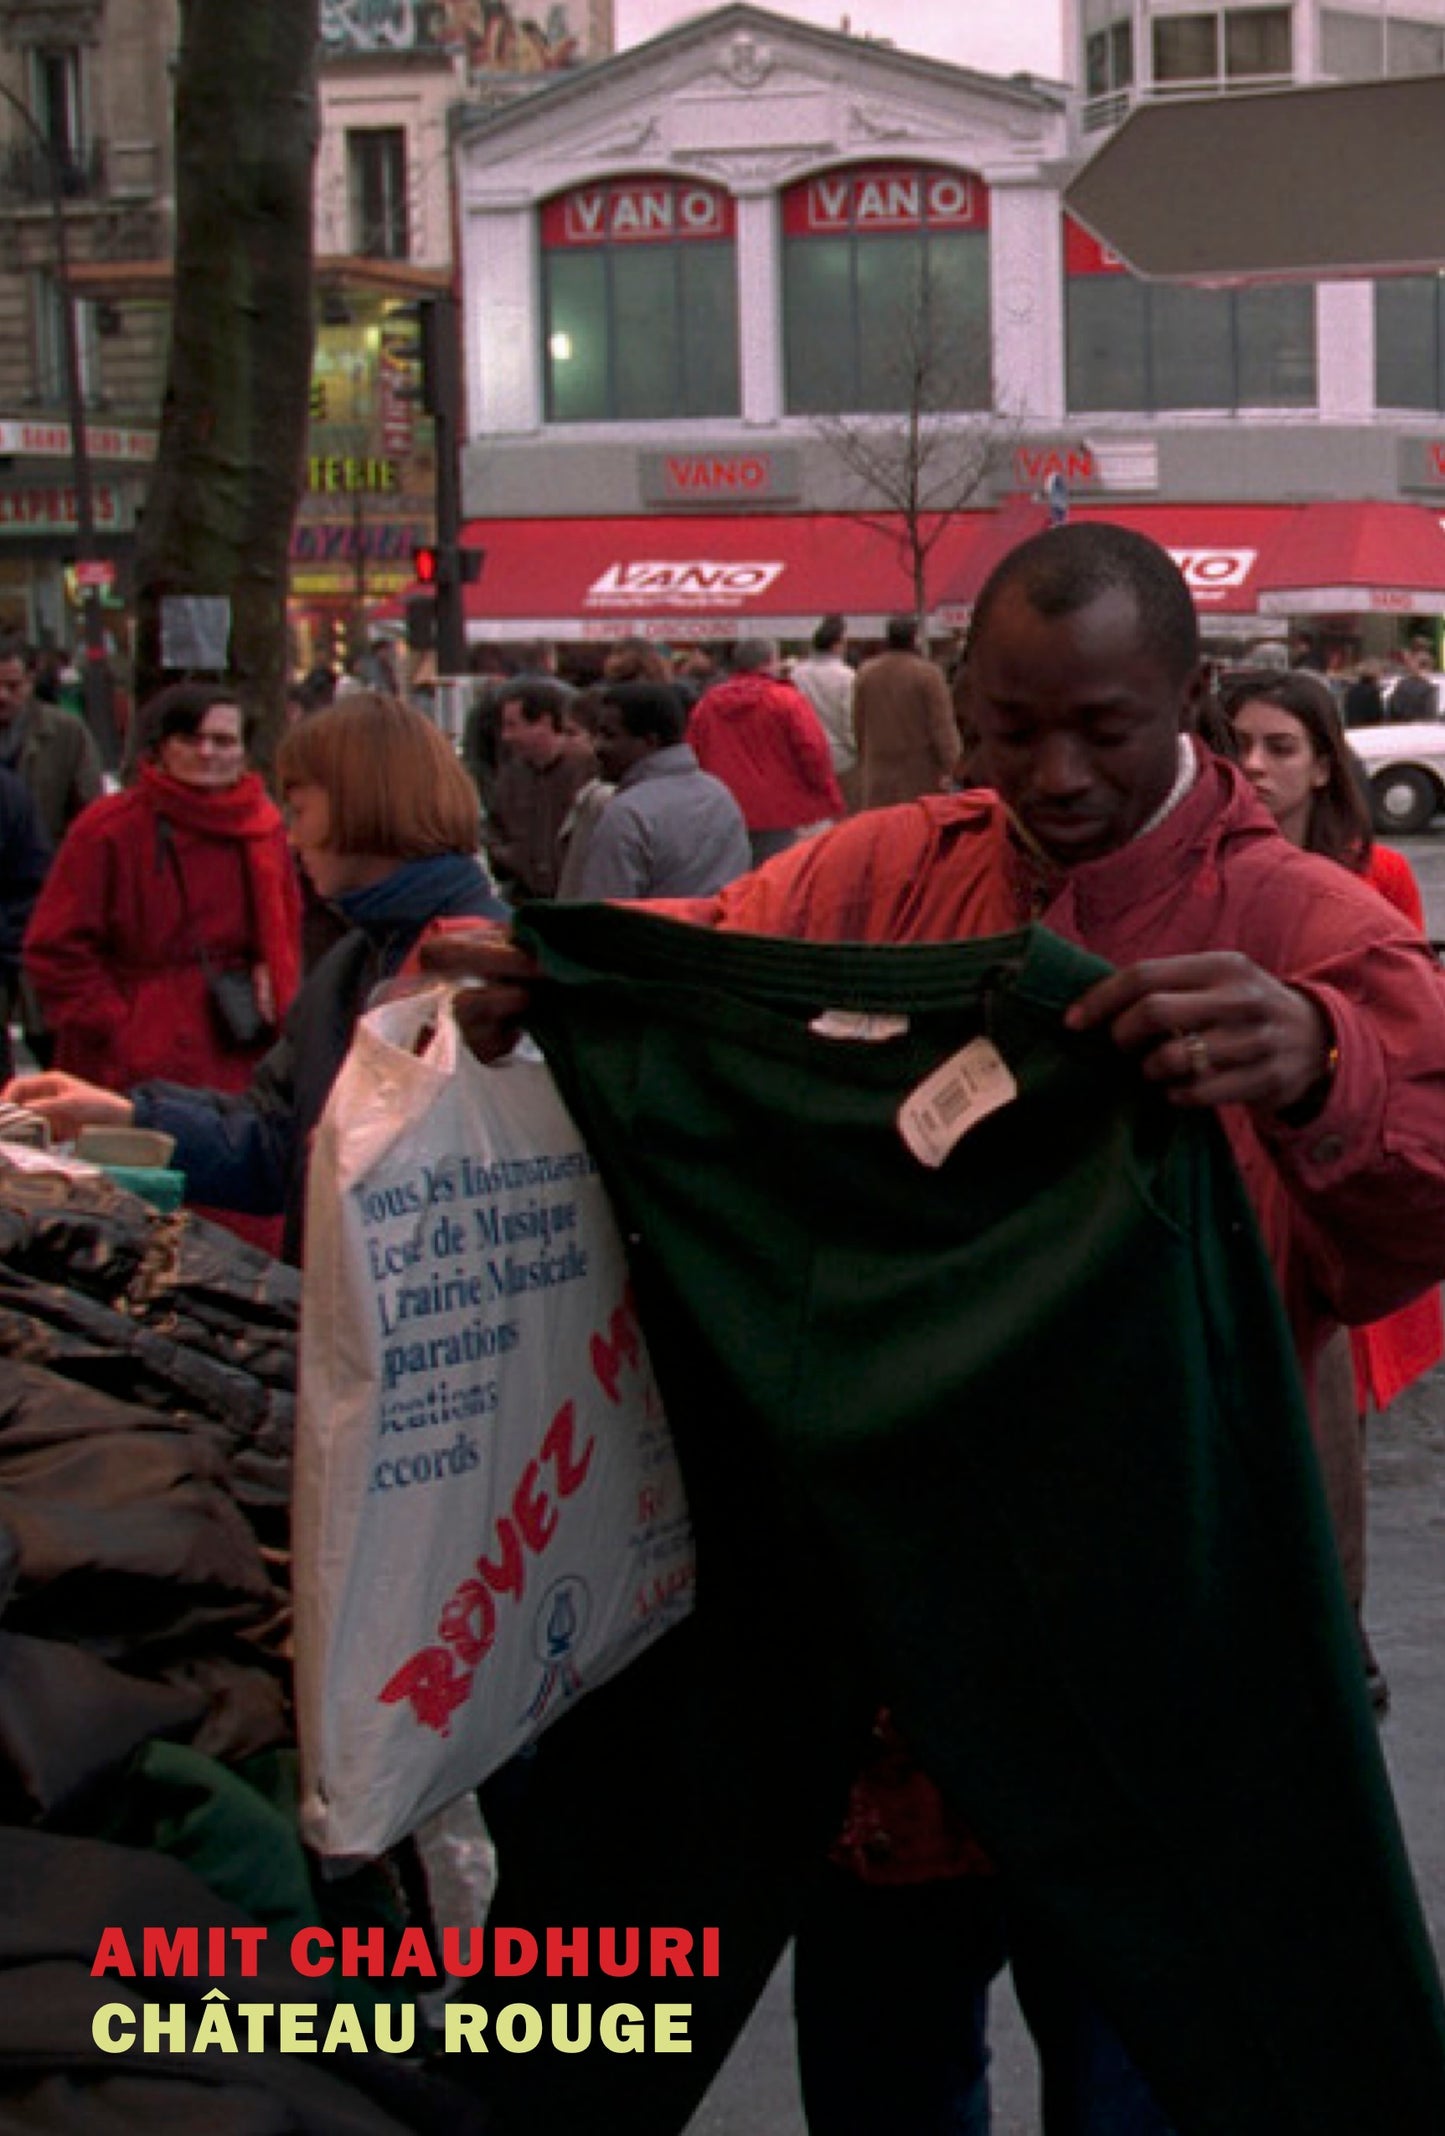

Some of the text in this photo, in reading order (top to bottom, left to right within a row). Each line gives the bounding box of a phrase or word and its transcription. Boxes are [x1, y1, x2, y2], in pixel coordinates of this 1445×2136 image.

[574, 188, 717, 230] VANO
[819, 178, 966, 218] VANO
[667, 455, 767, 488] VANO
[1015, 446, 1094, 480] VAN
[608, 562, 772, 590] VANO
[431, 1216, 466, 1258] de
[474, 1200, 577, 1248] Musique
[487, 1242, 589, 1297] Musicale
[382, 1318, 520, 1391] parations
[368, 1433, 481, 1493] ccords
